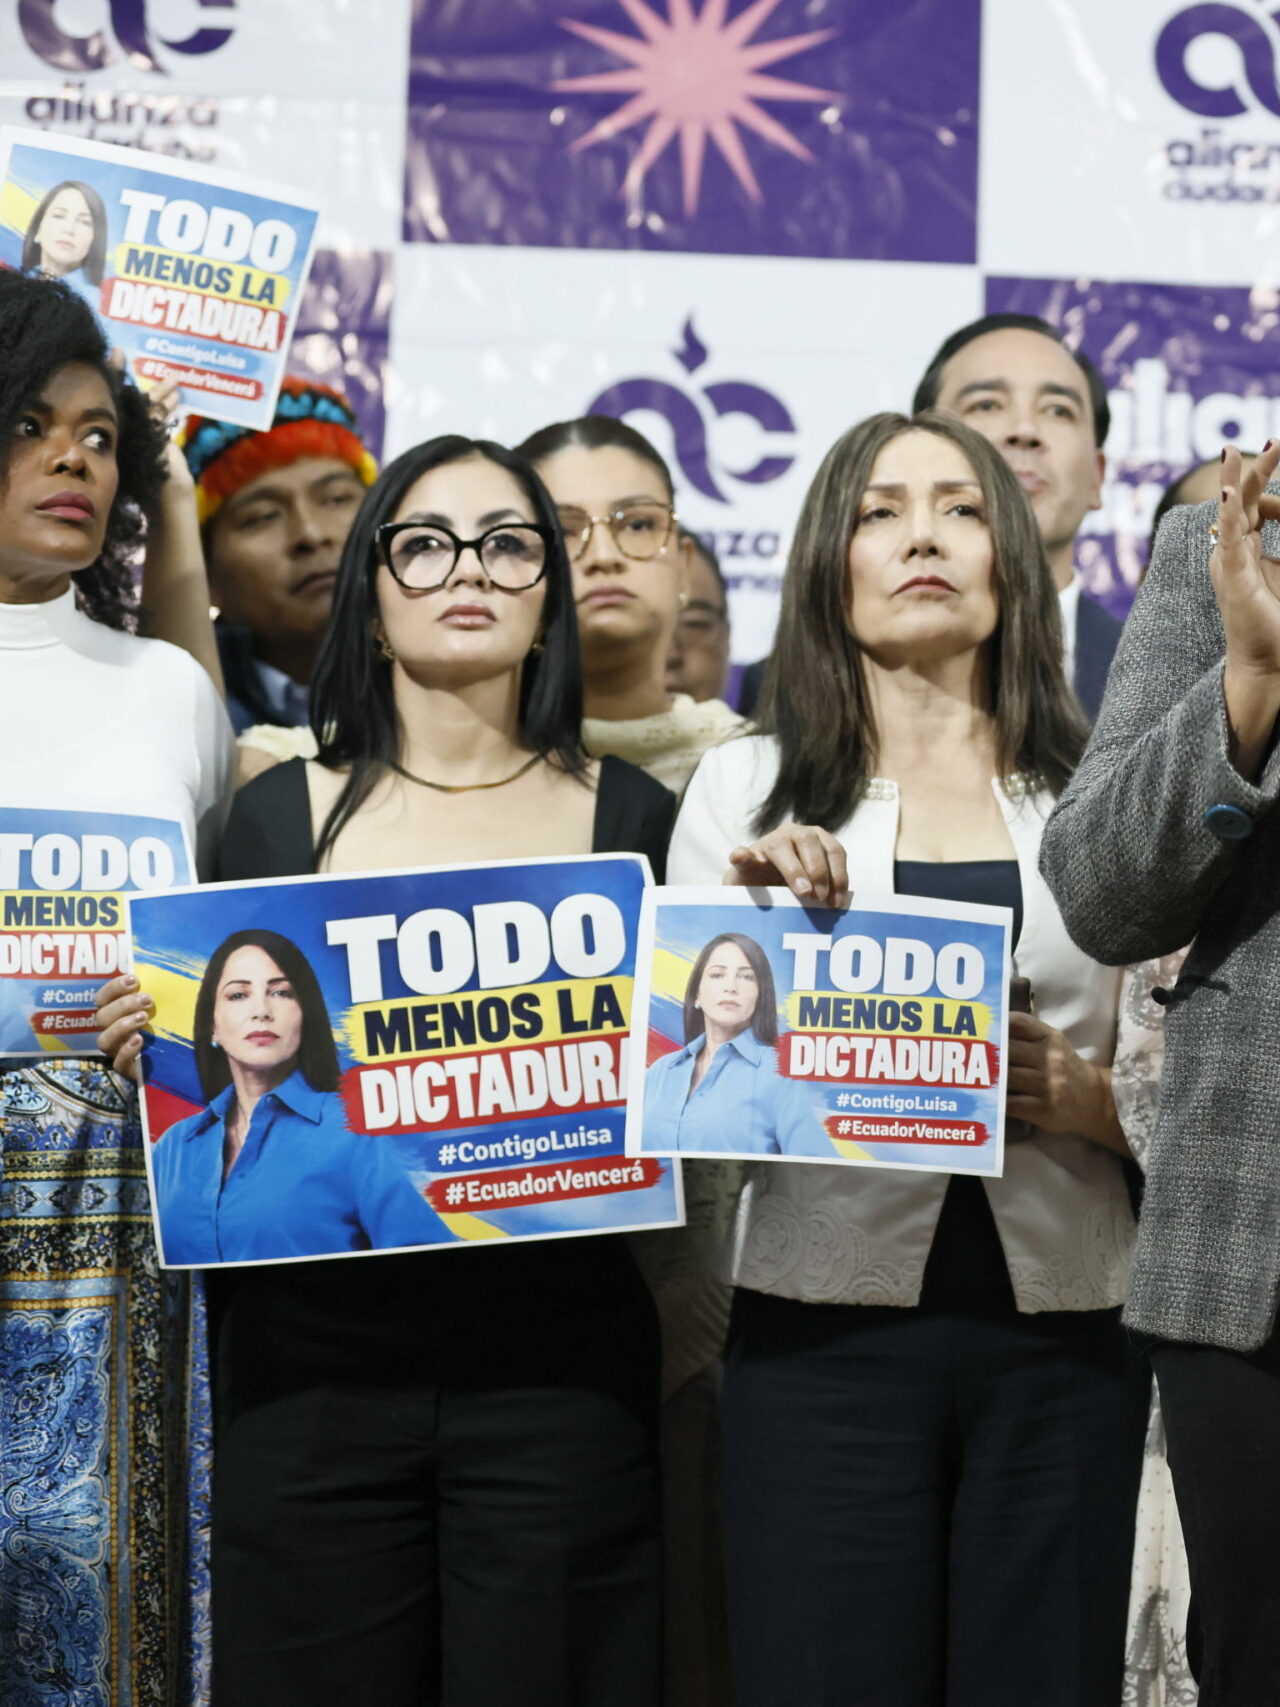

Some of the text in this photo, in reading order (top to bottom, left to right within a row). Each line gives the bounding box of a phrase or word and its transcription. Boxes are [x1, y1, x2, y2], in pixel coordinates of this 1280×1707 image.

[121, 189, 297, 273] TODO
[124, 248, 276, 305] MENOS LA
[109, 279, 280, 350] DICTADURA
[145, 337, 247, 370] #ContigoLuisa
[0, 833, 175, 891] TODO
[4, 896, 119, 927] MENOS
[326, 893, 626, 1003] TODO
[782, 932, 985, 1000] TODO
[364, 984, 625, 1057] MENOS LA
[798, 996, 977, 1036] MENOS LA
[789, 1035, 990, 1086] DICTADURA
[836, 1092, 958, 1113] #ContigoLuisa
[438, 1126, 612, 1166] #ContigoLuisa
[837, 1119, 976, 1142] #EcuadorVencerá
[445, 1160, 645, 1205] #EcuadorVencerá
